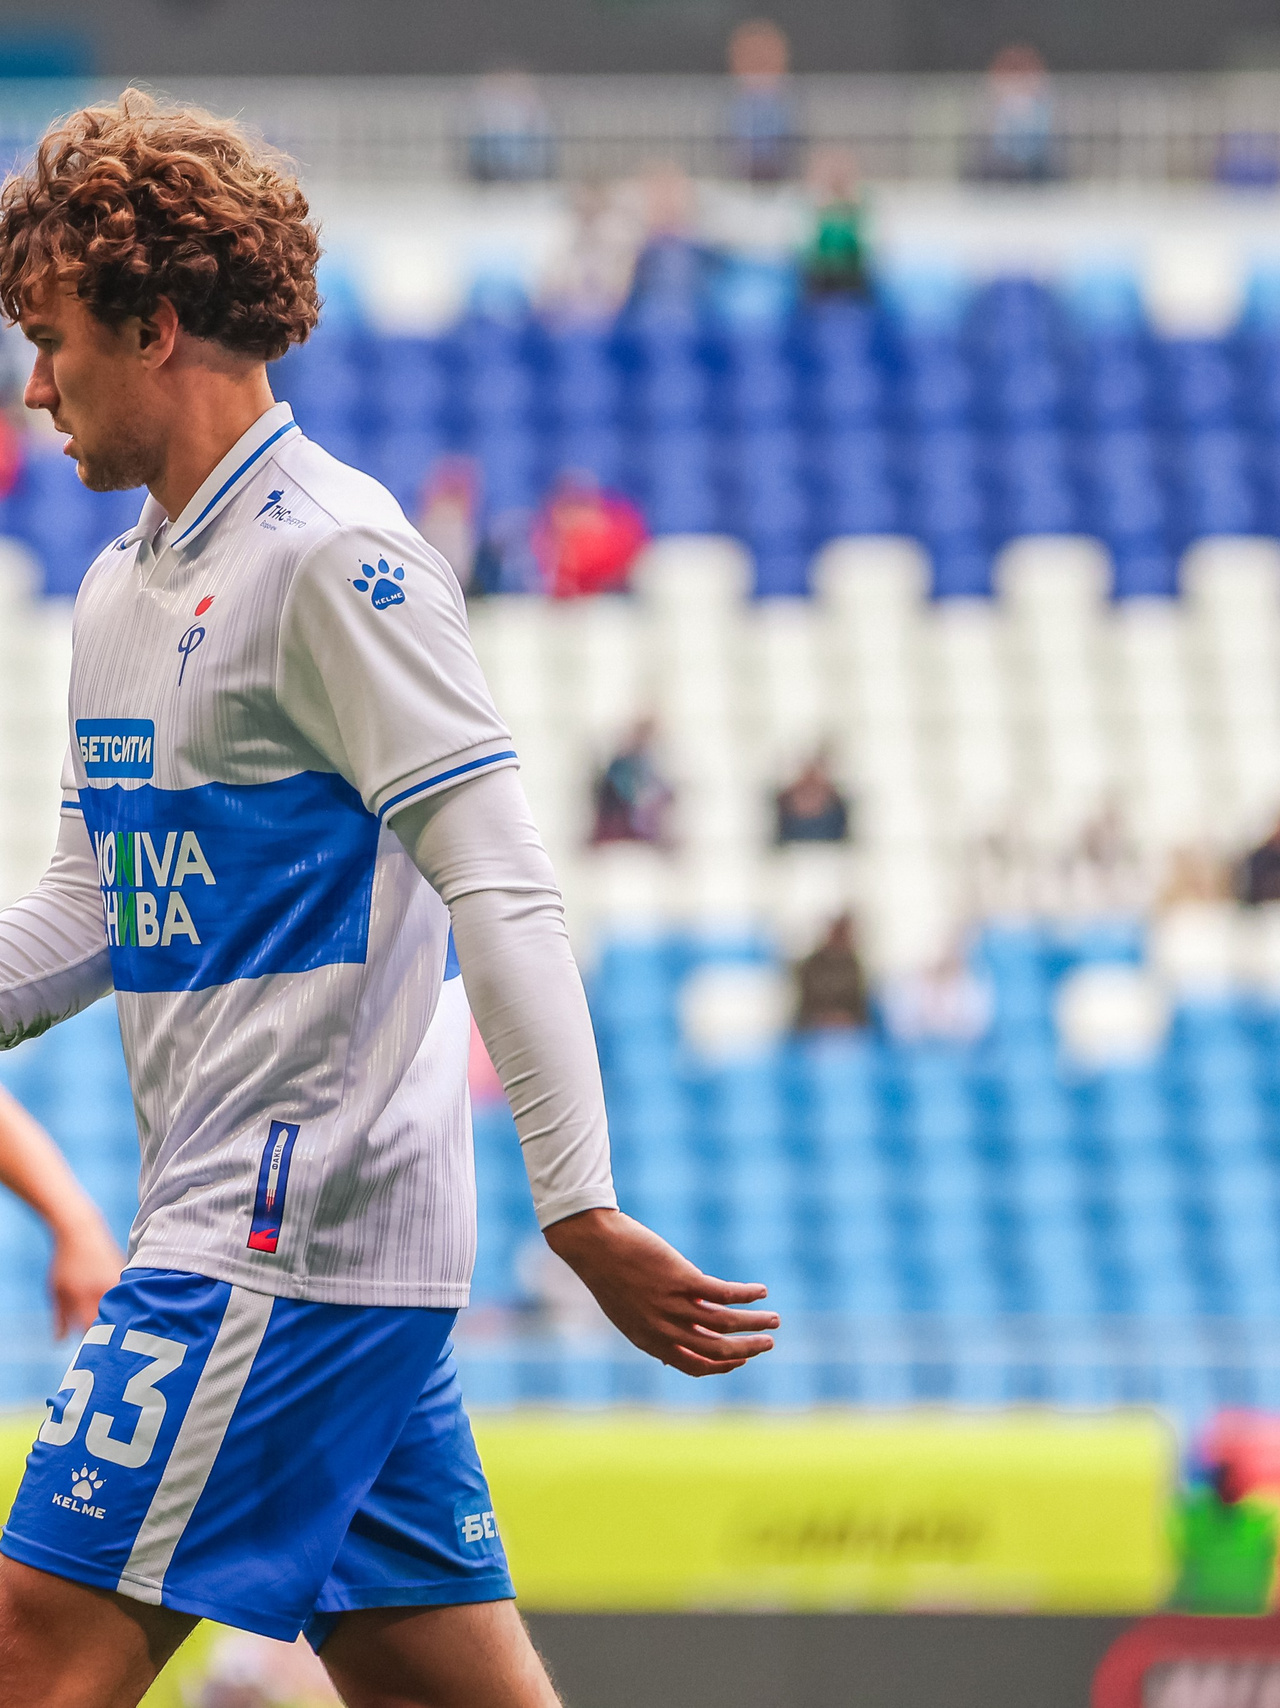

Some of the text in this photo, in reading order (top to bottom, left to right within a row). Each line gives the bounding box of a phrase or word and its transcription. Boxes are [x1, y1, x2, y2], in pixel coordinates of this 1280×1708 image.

[375, 592, 403, 605] KELME
[79, 735, 152, 763] БЕТСИТИ
[271, 1143, 284, 1170] ФАКЕЛ
[38, 1323, 188, 1469] 53
[51, 1492, 107, 1520] KELME
